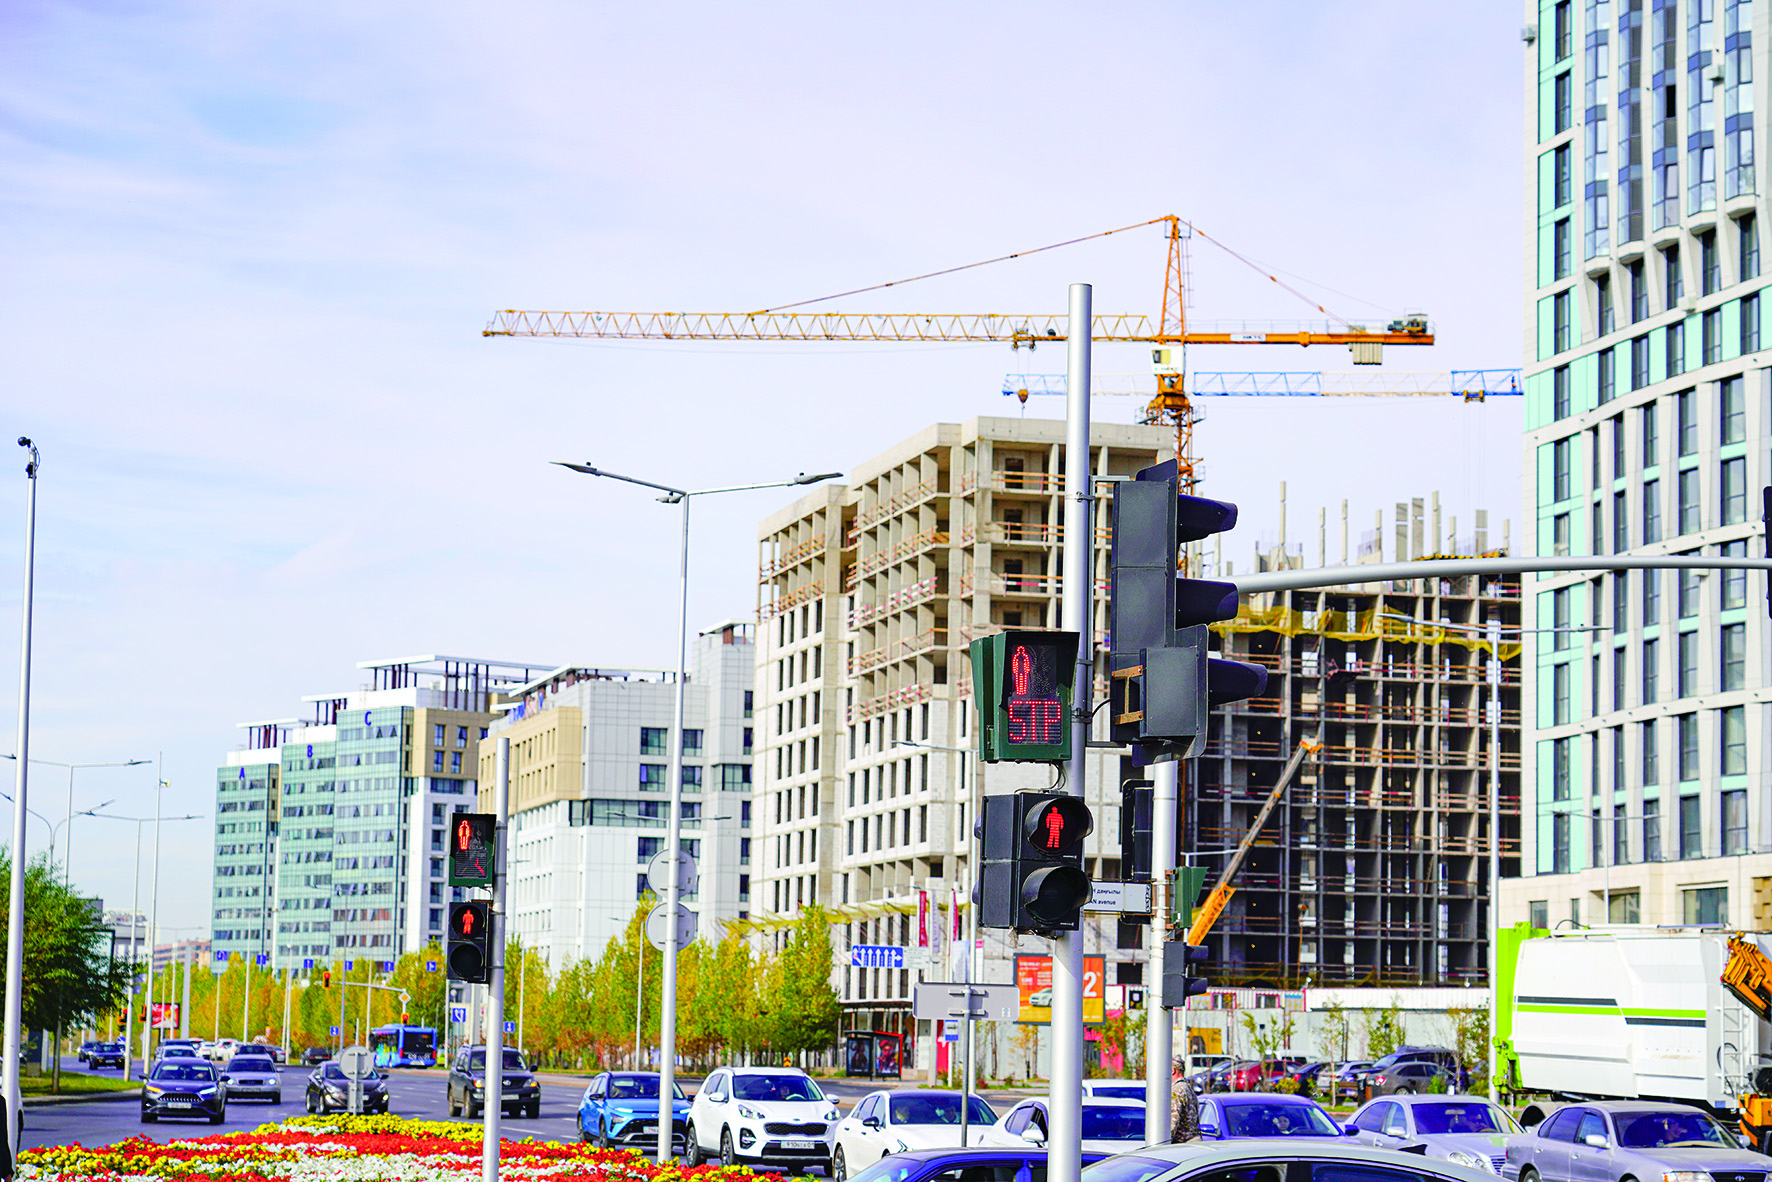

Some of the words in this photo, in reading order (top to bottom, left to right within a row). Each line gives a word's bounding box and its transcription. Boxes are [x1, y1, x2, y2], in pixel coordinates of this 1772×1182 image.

[364, 711, 371, 726] C
[1009, 700, 1061, 741] STP
[307, 745, 313, 758] B
[239, 767, 245, 779] A
